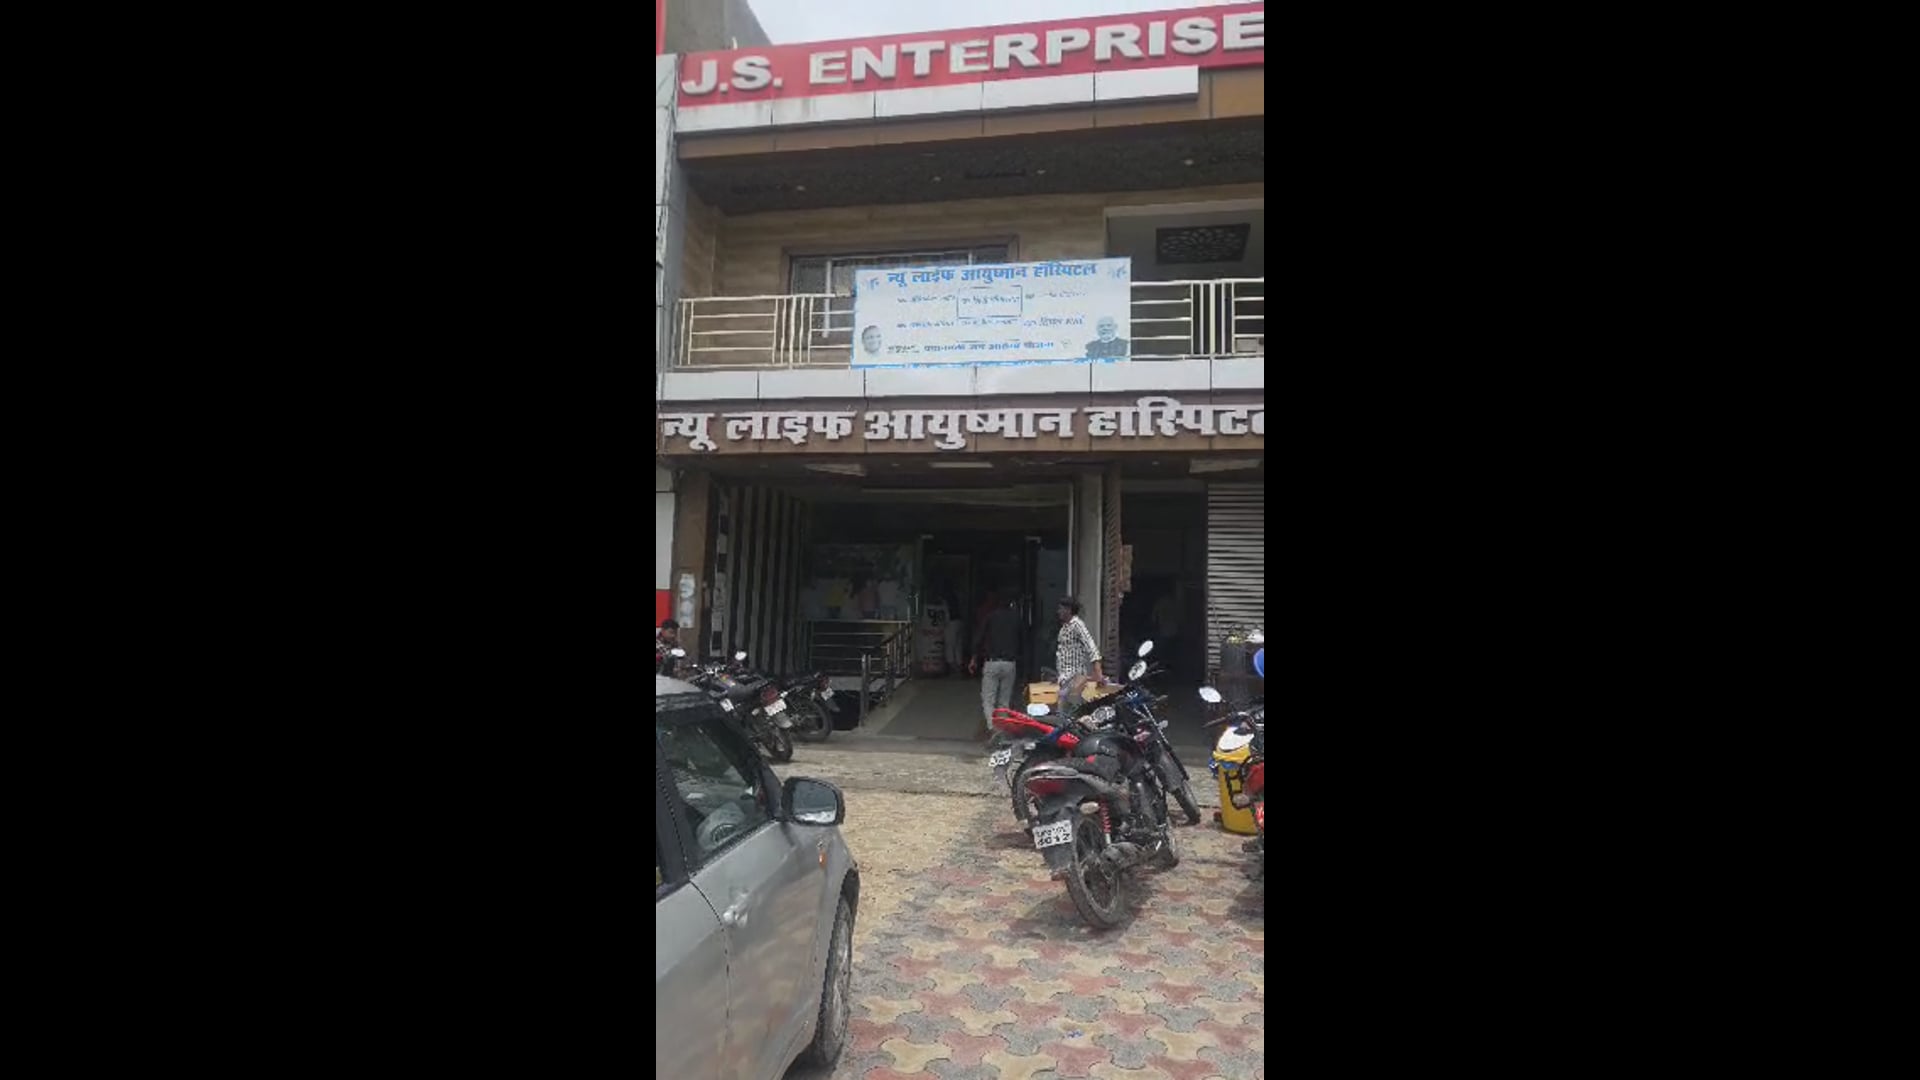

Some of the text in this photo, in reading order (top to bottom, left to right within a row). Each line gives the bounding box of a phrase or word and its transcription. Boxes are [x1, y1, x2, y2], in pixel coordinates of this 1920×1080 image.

[682, 12, 1264, 95] J.S. ENTERPRISE
[887, 272, 907, 287] न्यू
[657, 412, 718, 452] न्यू
[722, 411, 857, 445] लाइफ
[864, 408, 1078, 450] आयुष्मान
